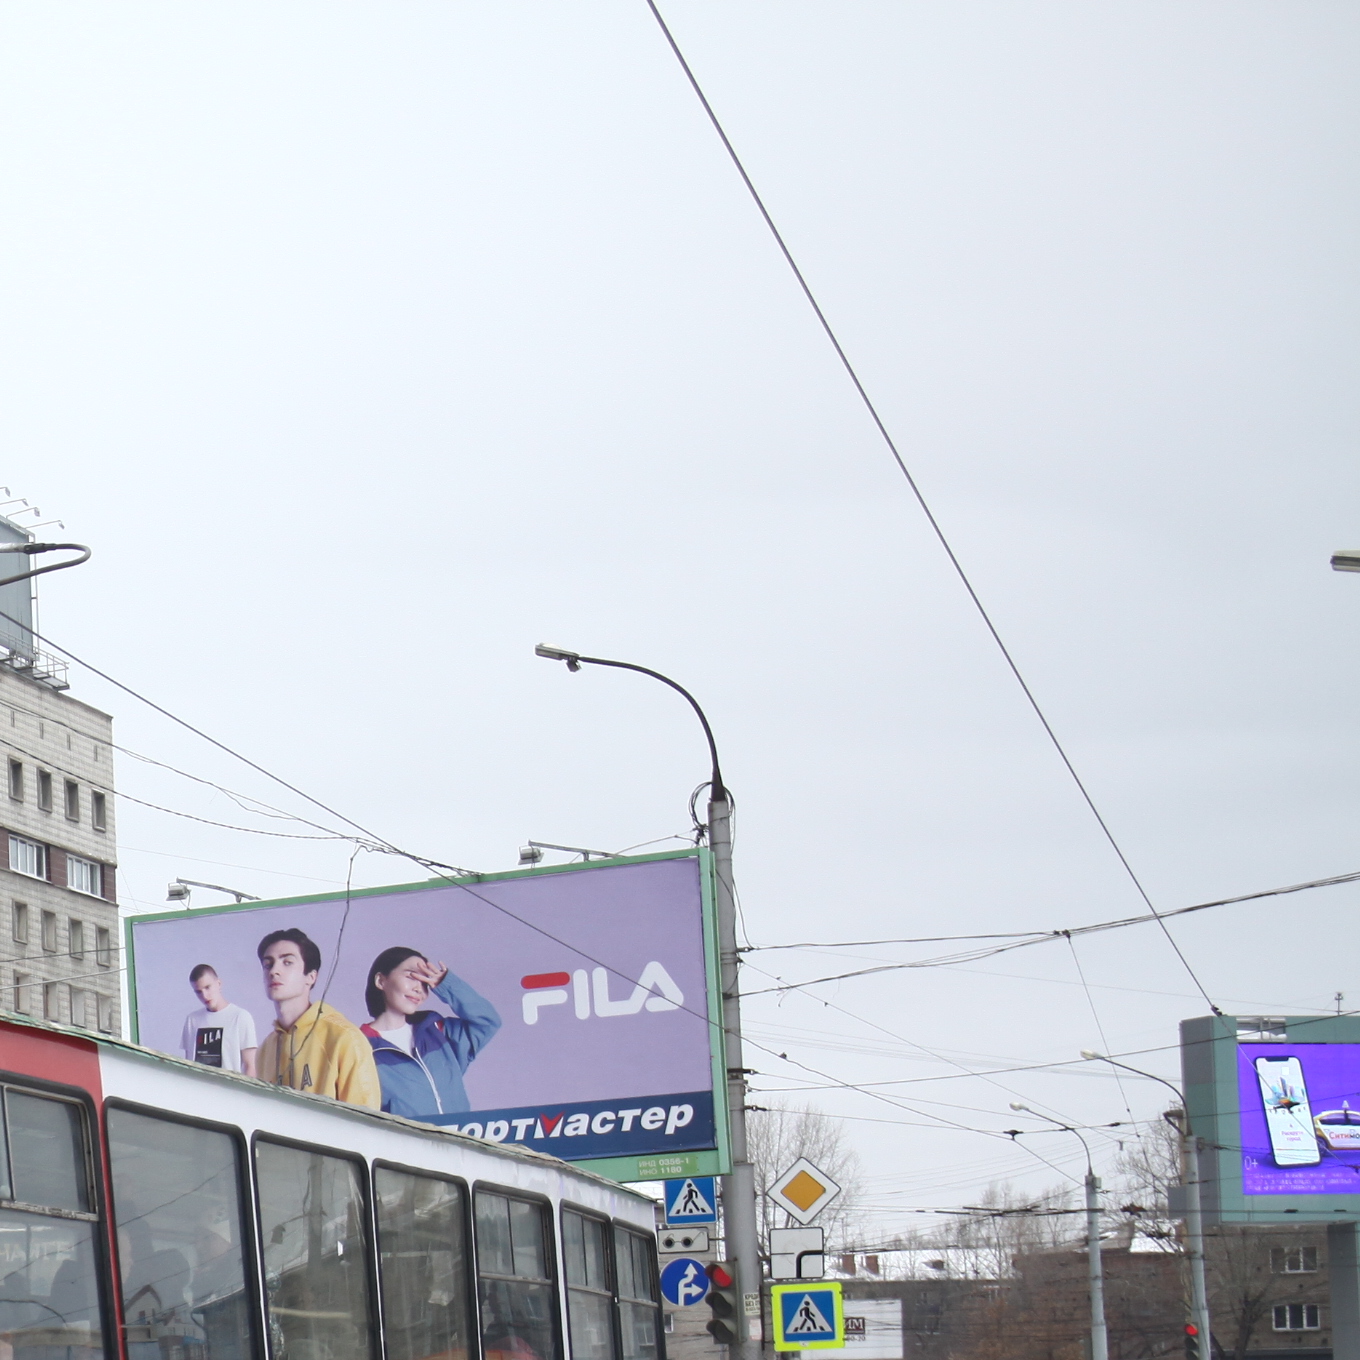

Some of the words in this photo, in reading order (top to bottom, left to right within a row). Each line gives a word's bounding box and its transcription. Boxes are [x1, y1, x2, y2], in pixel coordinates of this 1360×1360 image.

[521, 960, 684, 1025] FILA
[639, 1160, 657, 1168] ИНД
[1244, 1156, 1258, 1171] 0+
[640, 1168, 657, 1176] ИНО
